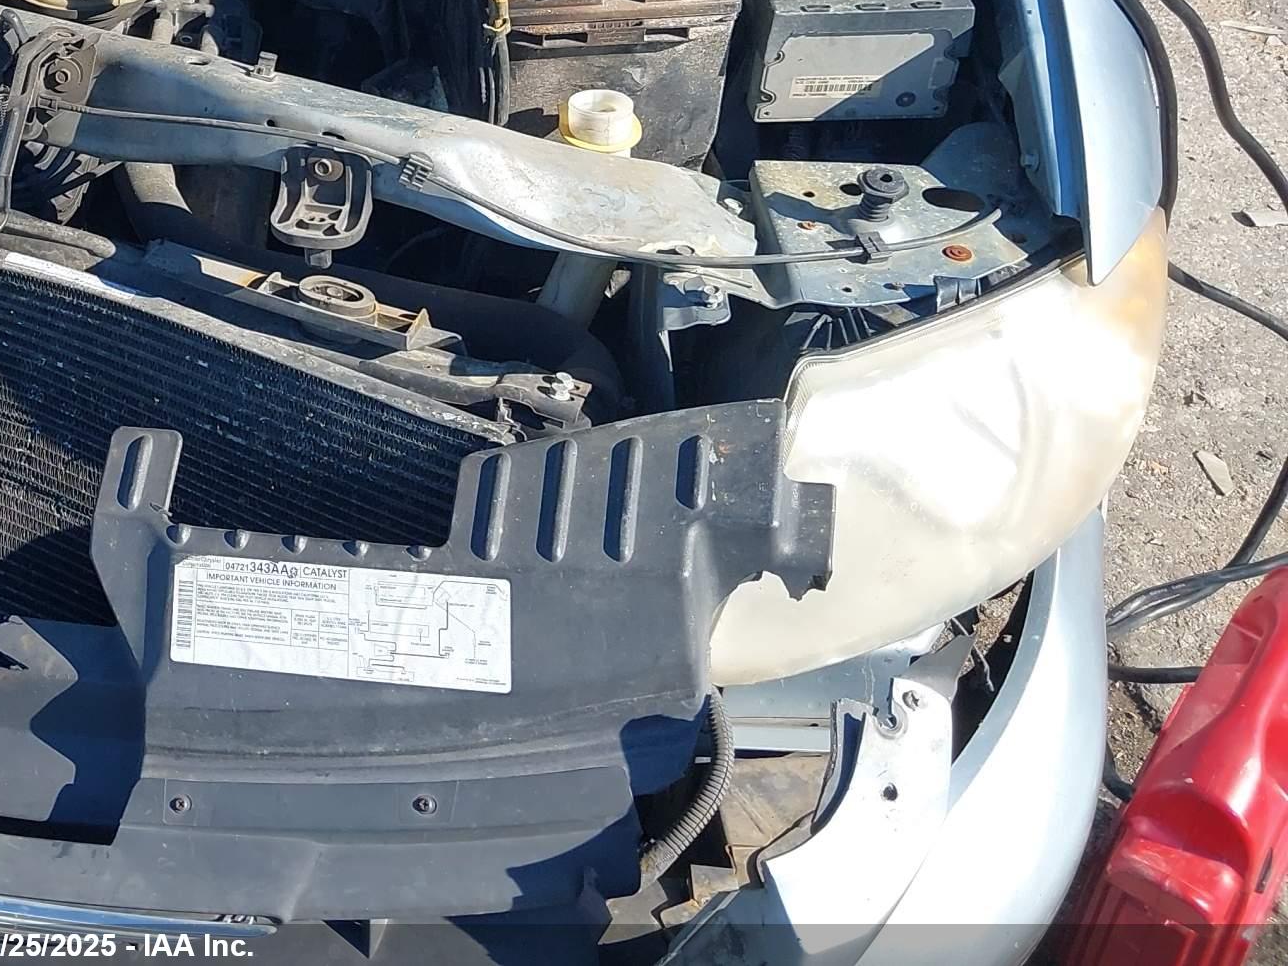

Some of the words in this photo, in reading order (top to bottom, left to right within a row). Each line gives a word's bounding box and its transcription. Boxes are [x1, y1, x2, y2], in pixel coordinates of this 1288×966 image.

[302, 566, 347, 579] CATALYST
[206, 572, 248, 584] IMPORTANT
[250, 576, 280, 586] VEHICLE
[282, 579, 337, 591] INFORMATION
